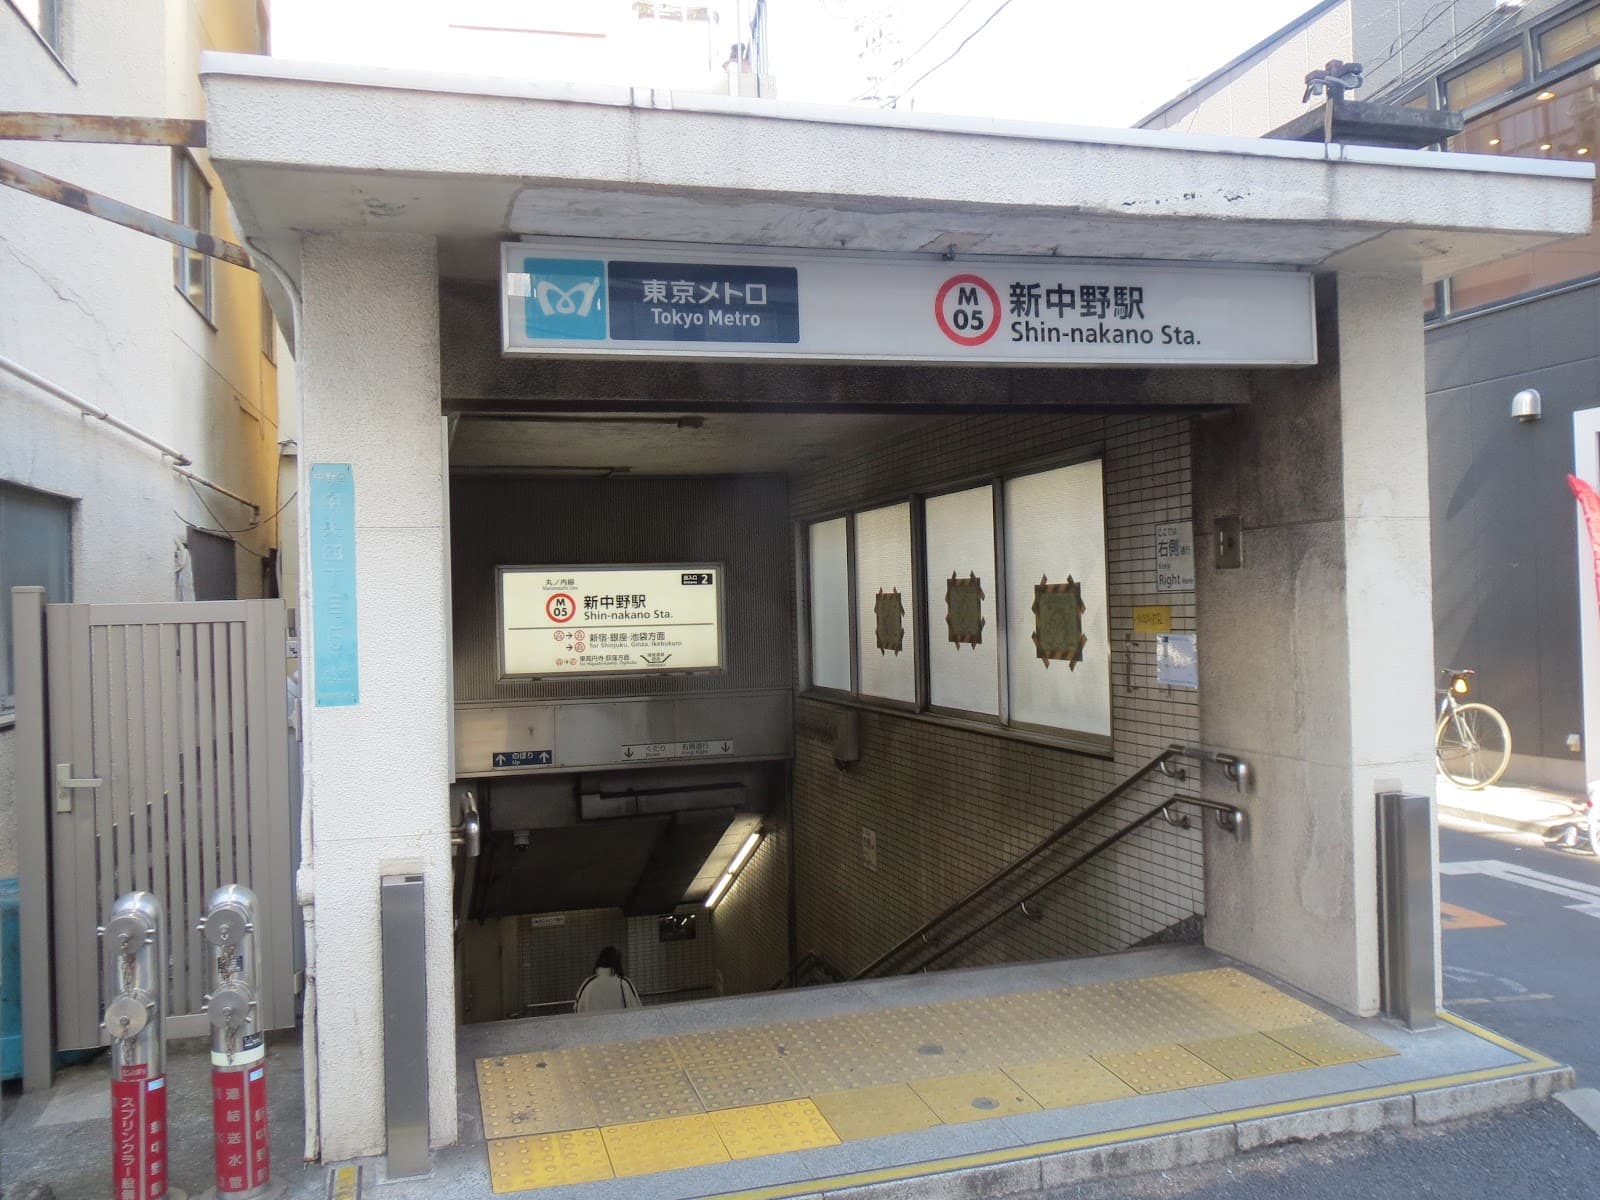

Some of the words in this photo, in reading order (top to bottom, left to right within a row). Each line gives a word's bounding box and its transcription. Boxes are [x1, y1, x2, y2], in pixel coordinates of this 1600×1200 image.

[642, 279, 767, 305] 東京メトロ
[957, 287, 979, 306] M
[1009, 282, 1145, 320] 新中野駅
[650, 308, 704, 329] Tokyo
[708, 309, 761, 327] Metro
[953, 309, 985, 331] 05
[1011, 321, 1154, 345] Shin-nakano
[1161, 324, 1202, 346] Sta.
[701, 574, 709, 584] 2
[1158, 573, 1181, 588] Right
[555, 598, 566, 607] M
[583, 594, 647, 610] 新中野駅
[553, 607, 568, 617] 05
[584, 610, 651, 621] Shin-nakano
[653, 609, 673, 619] Sta.
